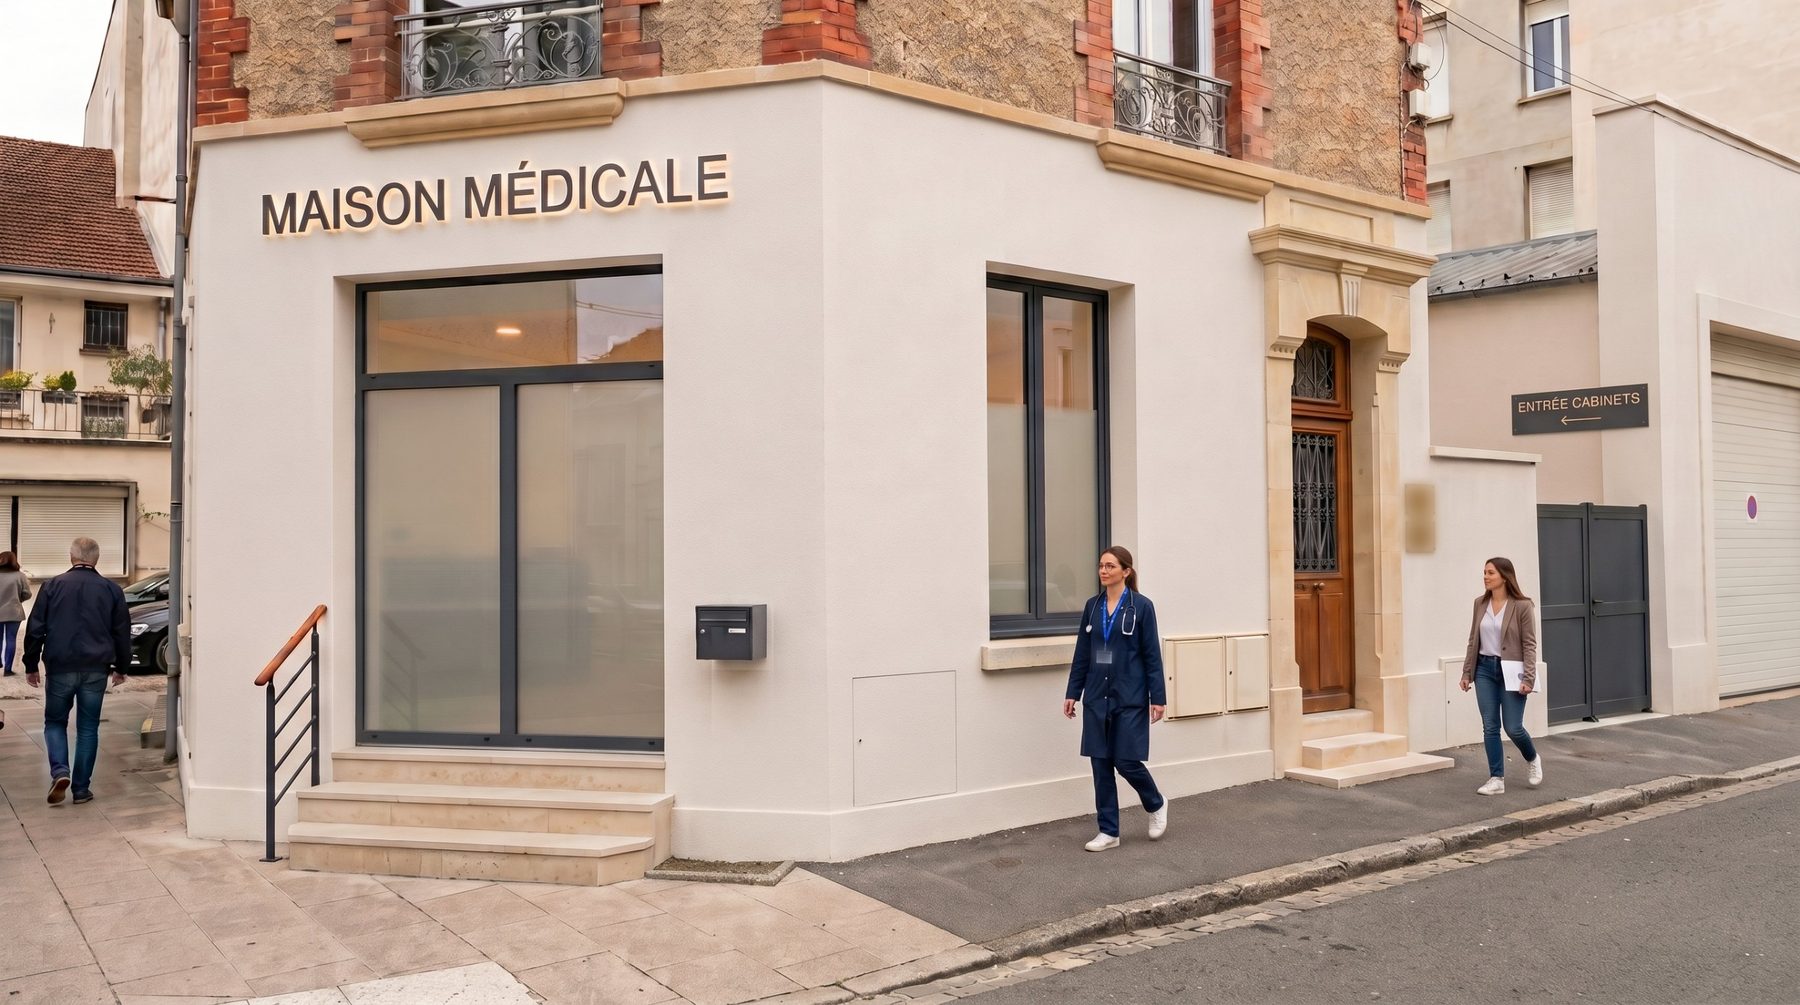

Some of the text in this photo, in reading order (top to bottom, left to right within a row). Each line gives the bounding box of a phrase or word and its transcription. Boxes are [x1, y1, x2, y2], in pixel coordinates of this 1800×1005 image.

[261, 153, 729, 235] MAISON MÉDICALE
[1518, 392, 1640, 413] ENTRÉE CABINETS
